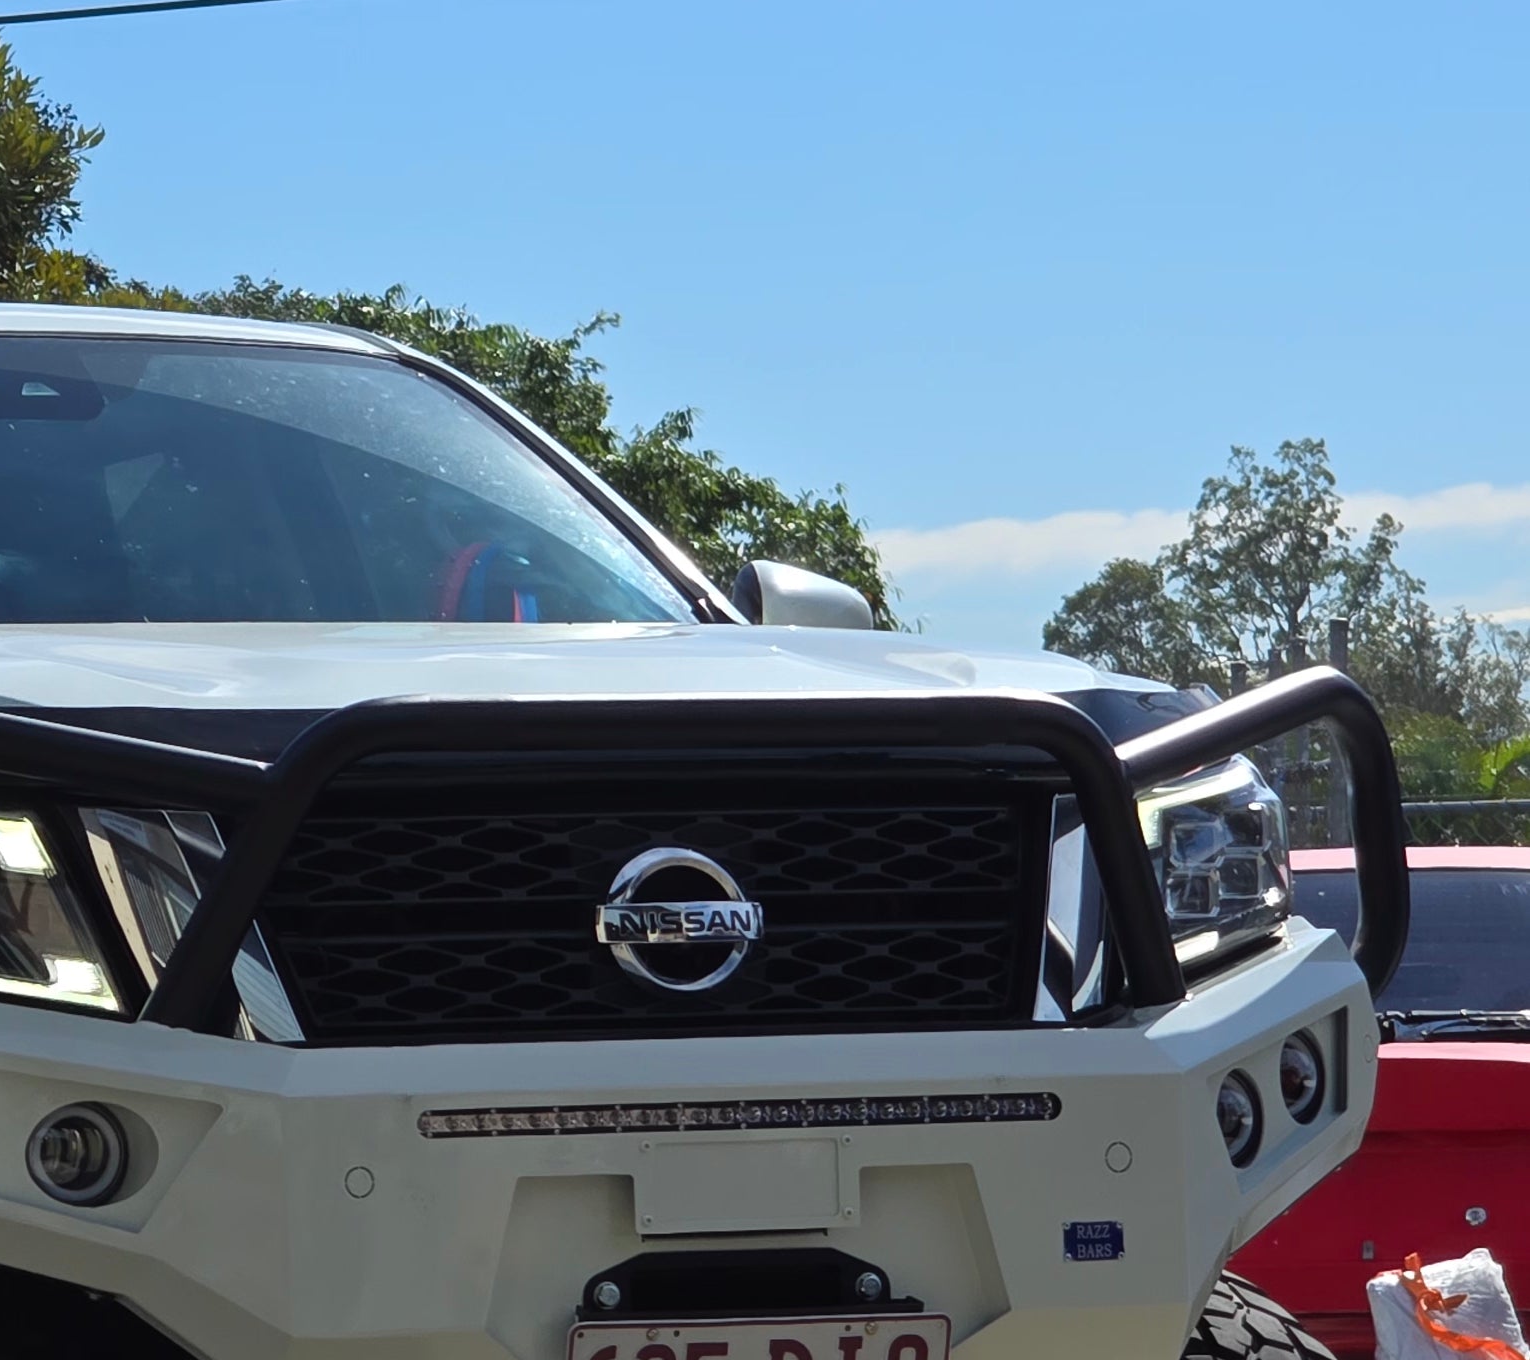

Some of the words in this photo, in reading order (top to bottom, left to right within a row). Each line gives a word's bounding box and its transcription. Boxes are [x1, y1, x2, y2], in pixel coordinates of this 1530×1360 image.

[619, 910, 752, 935] NISSAN
[1076, 1224, 1110, 1239] RAZZ
[1077, 1243, 1113, 1259] BARS
